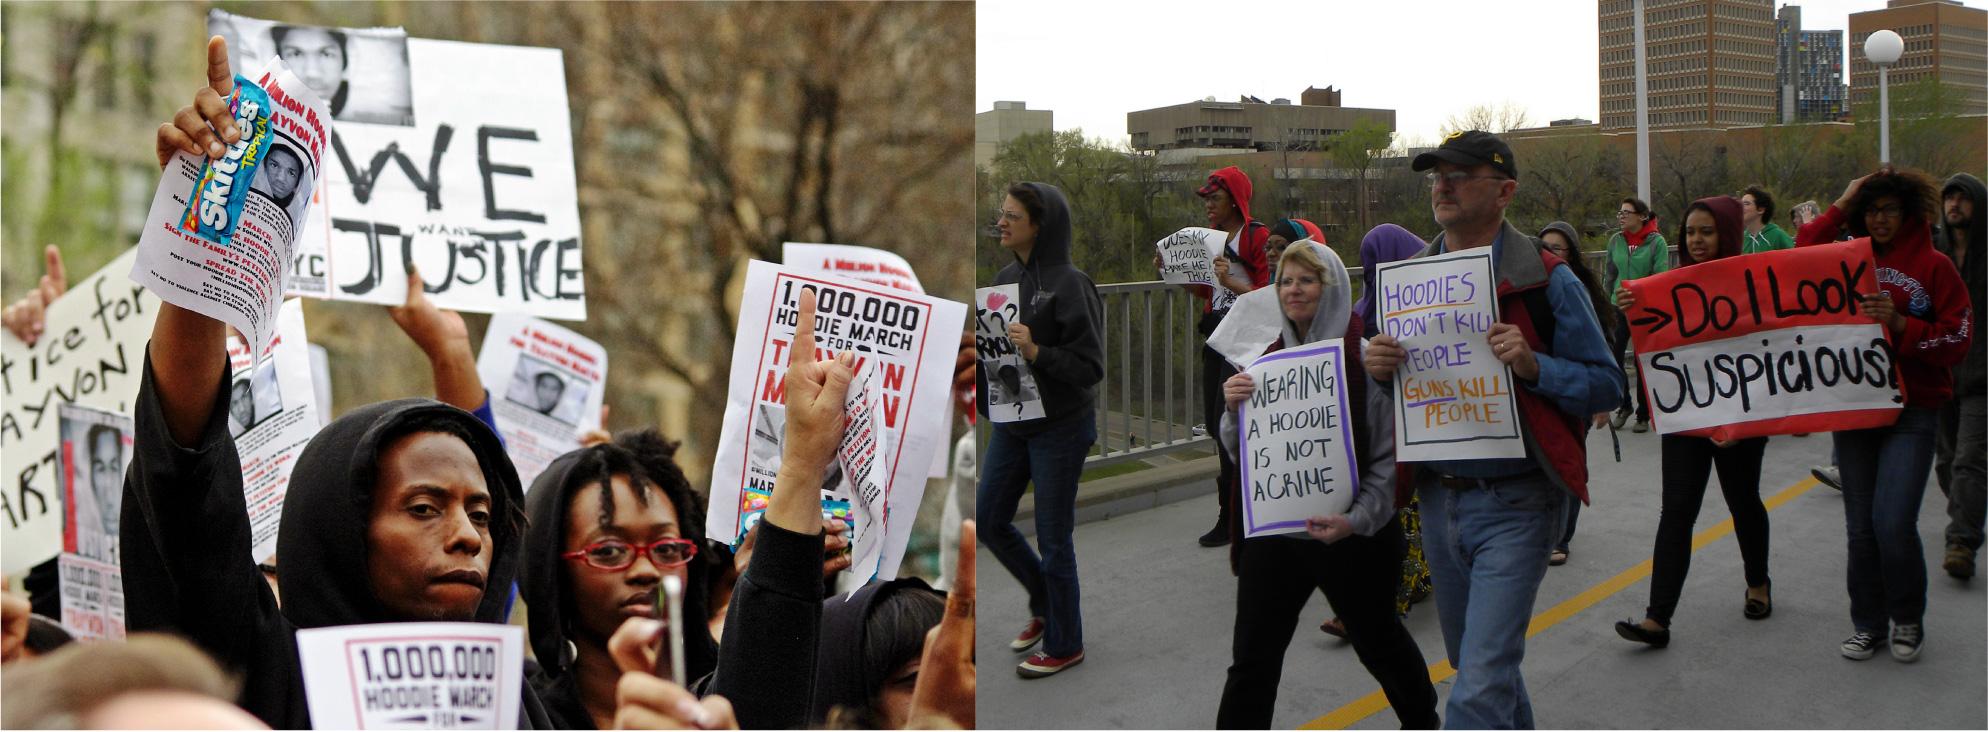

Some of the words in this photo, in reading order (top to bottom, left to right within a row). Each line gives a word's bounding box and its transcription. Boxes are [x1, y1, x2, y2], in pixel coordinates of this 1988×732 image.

[259, 72, 270, 88] A
[241, 116, 268, 170] TROPICAL
[270, 111, 311, 146] AYVON
[331, 124, 546, 224] WE
[170, 251, 184, 261] POST
[205, 259, 236, 275] SPREAD
[331, 218, 584, 301] JUSTICE
[1164, 263, 1188, 274] MAKE
[1192, 260, 1208, 271] ME
[1170, 249, 1208, 263] HOODIE
[202, 281, 213, 289] SAY
[1384, 272, 1475, 312] HOODIES
[1672, 282, 1739, 337] Do
[1745, 268, 1763, 325] I
[1767, 260, 1869, 319] Look
[783, 280, 920, 331] 1,00,000
[1, 327, 87, 395] tice
[92, 276, 145, 340] for
[776, 307, 842, 336] HODIE
[849, 323, 913, 351] MARCH
[1386, 312, 1447, 342] DON'T
[827, 337, 853, 351] FOR
[1403, 342, 1472, 374] PEOPLE
[1249, 360, 1334, 409] WEARING
[1404, 378, 1455, 402] GUNS
[1457, 376, 1508, 398] KILL
[1650, 337, 1904, 413] Suspicious?
[1013, 401, 1023, 421] ?
[1247, 418, 1260, 440] A
[1270, 404, 1337, 434] HOODIE
[1425, 402, 1502, 429] PEOPLE
[1255, 447, 1269, 469] IS
[1286, 439, 1331, 461] NOT
[750, 477, 775, 493] MAR
[751, 466, 777, 479] #MILLION
[1254, 481, 1265, 501] A
[1267, 467, 1334, 500] CRIME
[360, 645, 495, 682] 1,000,000
[364, 687, 442, 710] HOODIE
[449, 686, 494, 709] MARCH
